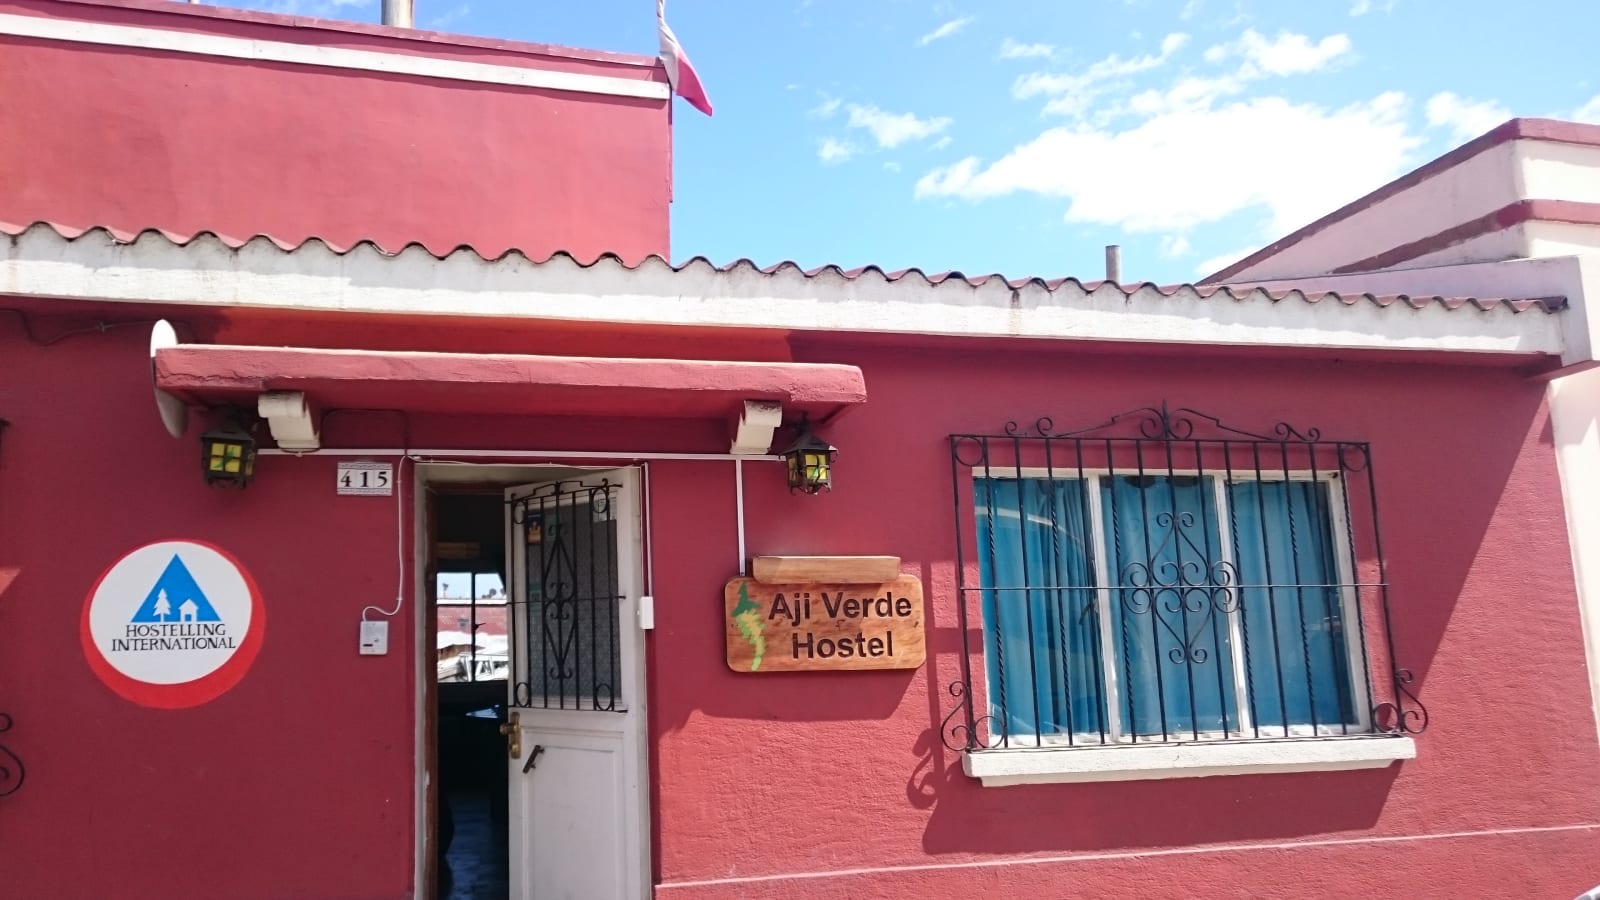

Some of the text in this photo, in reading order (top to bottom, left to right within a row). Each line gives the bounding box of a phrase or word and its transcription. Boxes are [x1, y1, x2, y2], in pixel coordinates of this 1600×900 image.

[340, 470, 388, 488] 415
[768, 591, 912, 627] Aji Verde
[125, 623, 226, 637] HOSTELLING
[111, 637, 236, 651] INTERNATIONAL
[792, 631, 893, 659] Hostel
